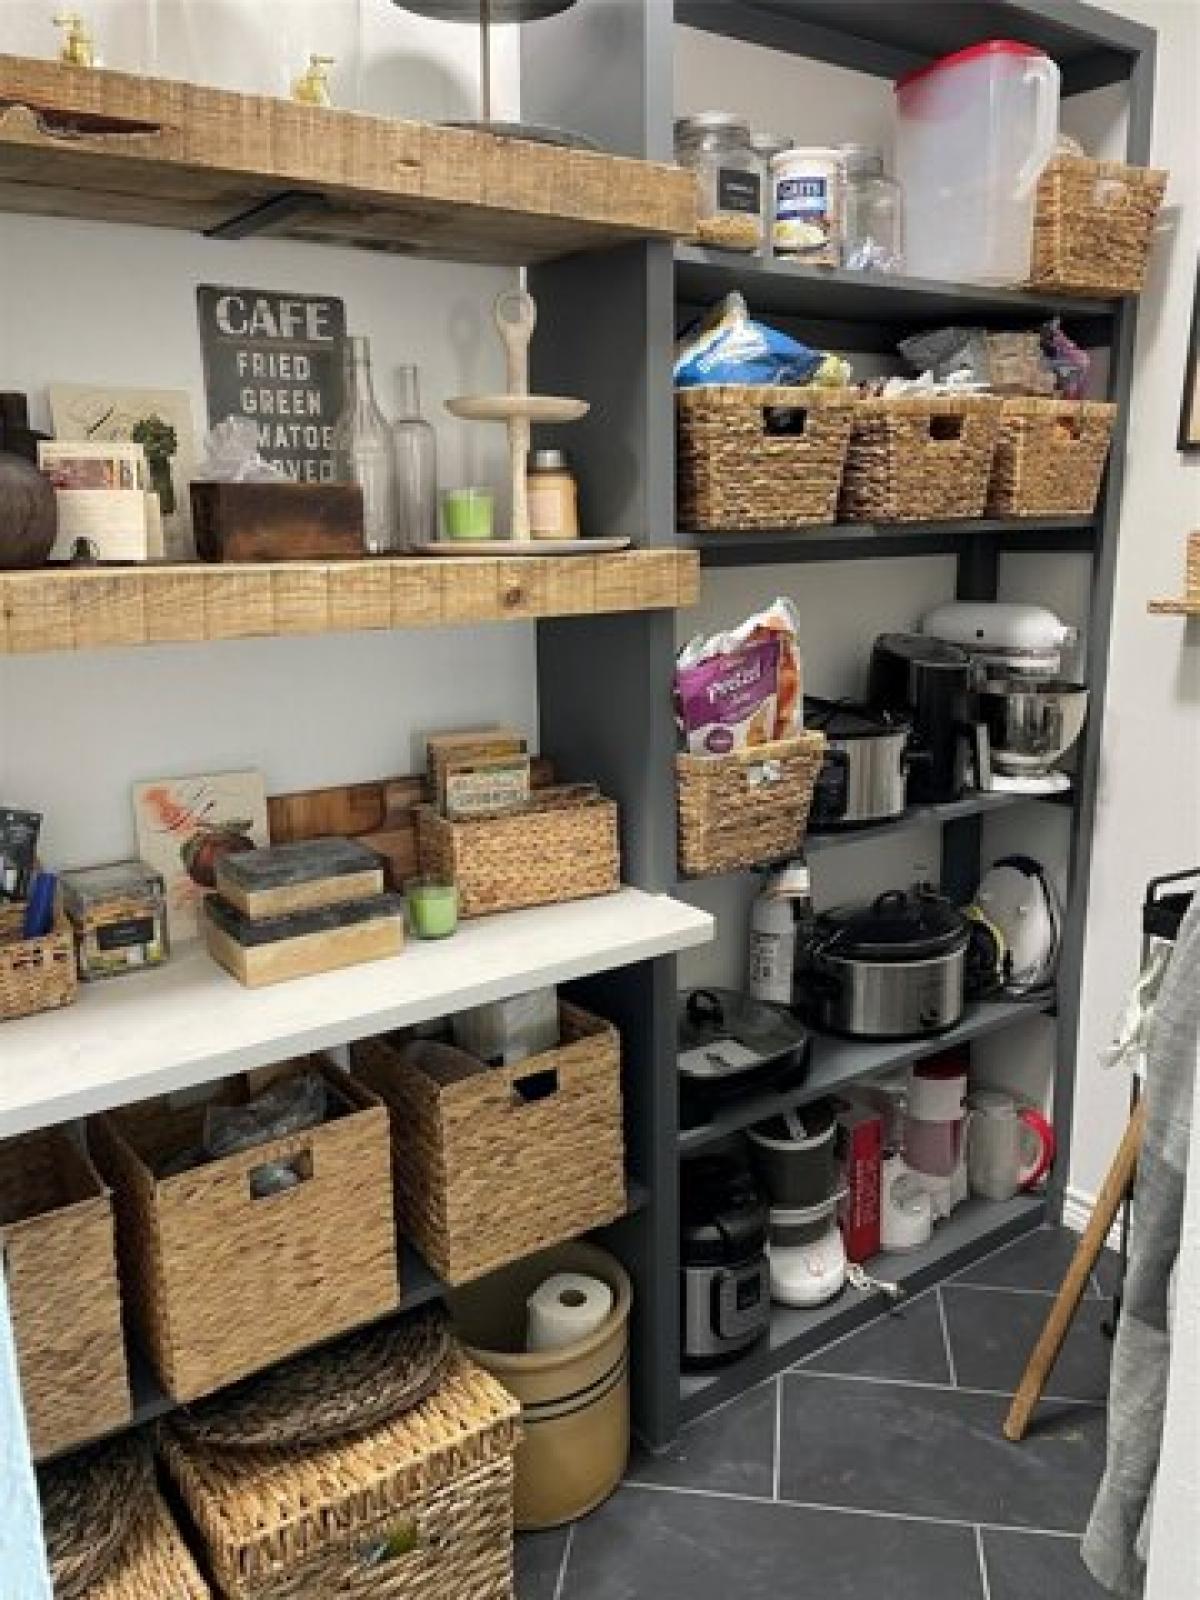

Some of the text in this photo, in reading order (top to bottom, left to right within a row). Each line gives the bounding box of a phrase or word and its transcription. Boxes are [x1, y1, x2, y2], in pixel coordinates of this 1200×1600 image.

[216, 296, 334, 340] CAFE
[237, 352, 311, 381] FRIED
[241, 389, 321, 416] GREEN
